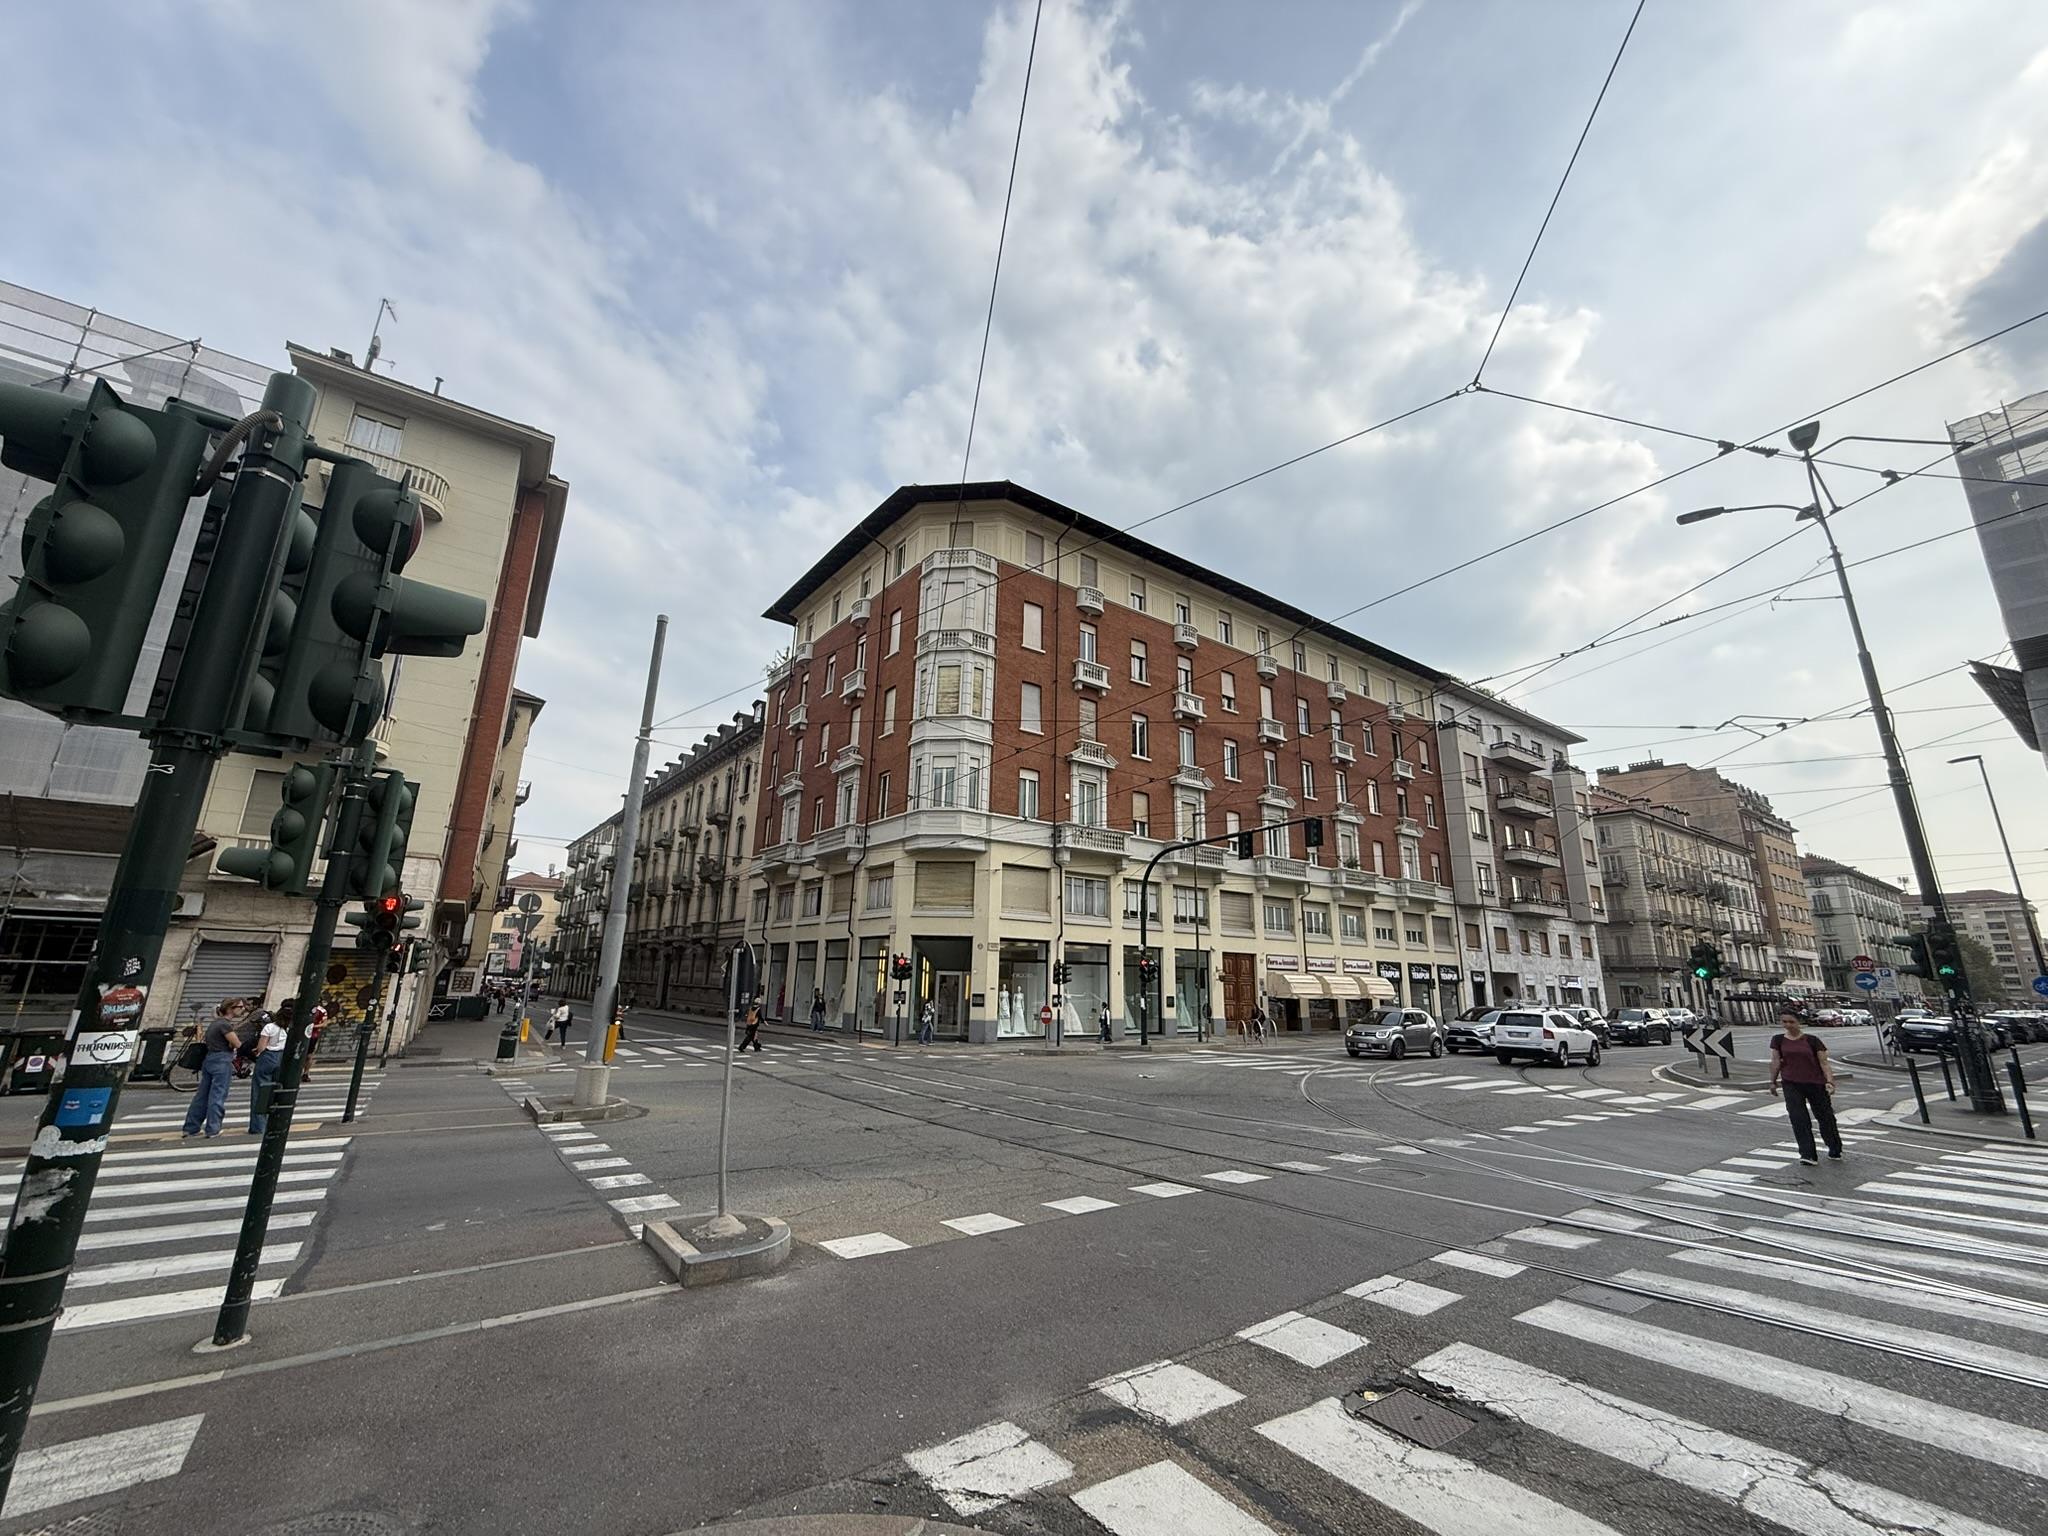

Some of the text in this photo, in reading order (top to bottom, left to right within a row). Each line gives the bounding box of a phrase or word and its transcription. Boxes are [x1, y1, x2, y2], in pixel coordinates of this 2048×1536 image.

[1852, 959, 1873, 967] STOP
[1380, 970, 1400, 978] TEMPUR
[1412, 971, 1430, 979] TEMPUR
